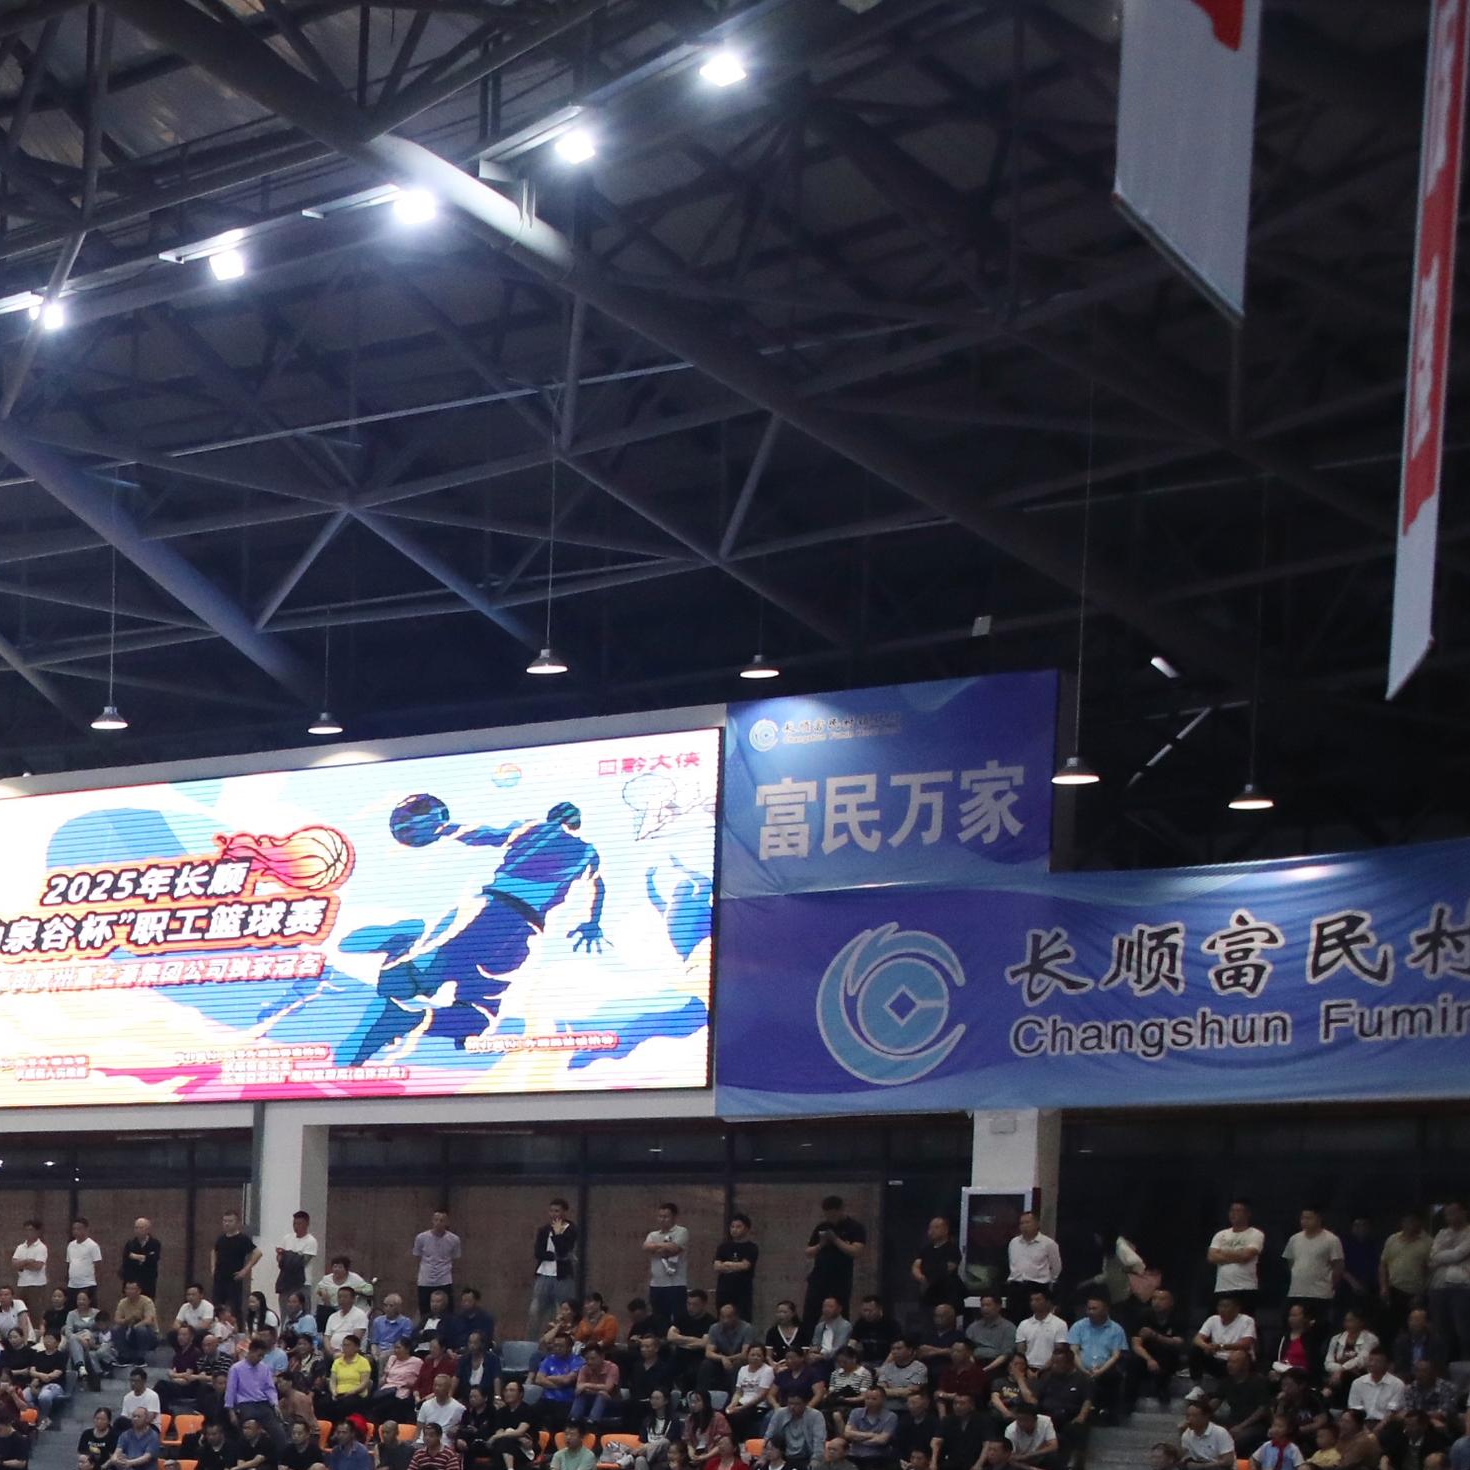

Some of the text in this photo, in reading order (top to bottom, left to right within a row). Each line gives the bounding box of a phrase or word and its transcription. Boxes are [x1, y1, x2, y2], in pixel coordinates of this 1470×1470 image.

[756, 760, 1025, 860] 富民万家
[42, 859, 250, 905] 2025年长顺
[1011, 1006, 1291, 1058] Changshun
